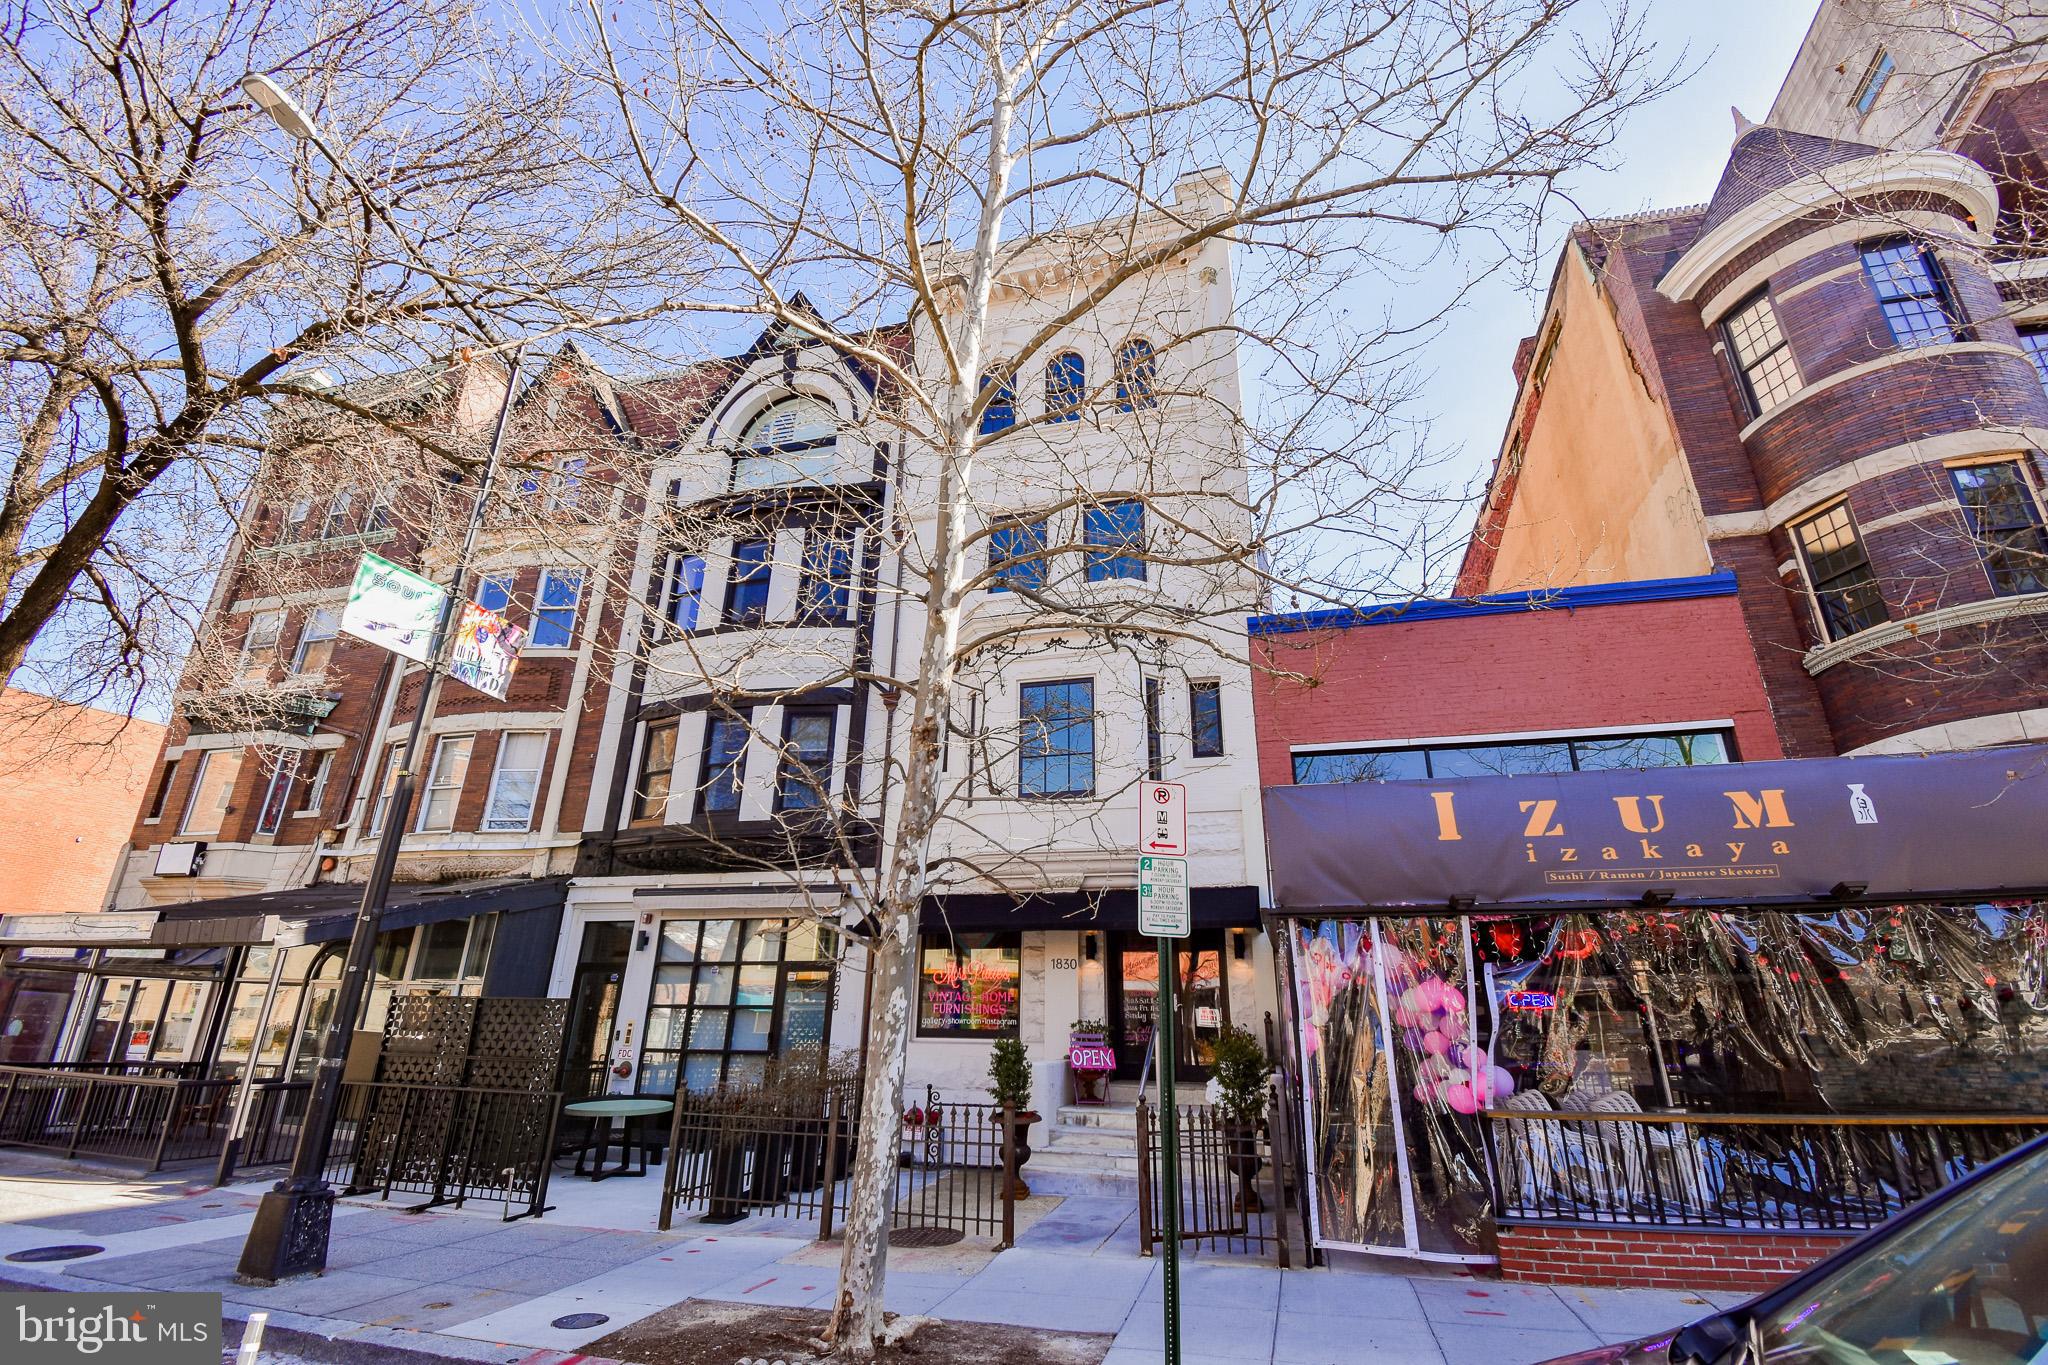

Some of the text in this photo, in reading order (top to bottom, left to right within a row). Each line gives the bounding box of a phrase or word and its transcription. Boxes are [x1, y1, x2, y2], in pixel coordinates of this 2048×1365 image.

[1526, 838, 1791, 863] izakaya
[1144, 860, 1150, 869] 2
[1153, 866, 1179, 874] PARKING
[1549, 872, 1585, 881] Sushi
[1599, 871, 1645, 880] Ramen
[1659, 869, 1716, 880] Japanese
[1719, 867, 1775, 877] Skewers
[1153, 893, 1180, 901] PARKING
[1050, 958, 1078, 970] 1830
[928, 991, 1015, 1003] VINTAGE HOME
[1510, 994, 1554, 1007] OPEN
[932, 1003, 1008, 1015] FURNISHINGS
[618, 1049, 632, 1058] FDC
[1071, 1049, 1113, 1067] OPEN
